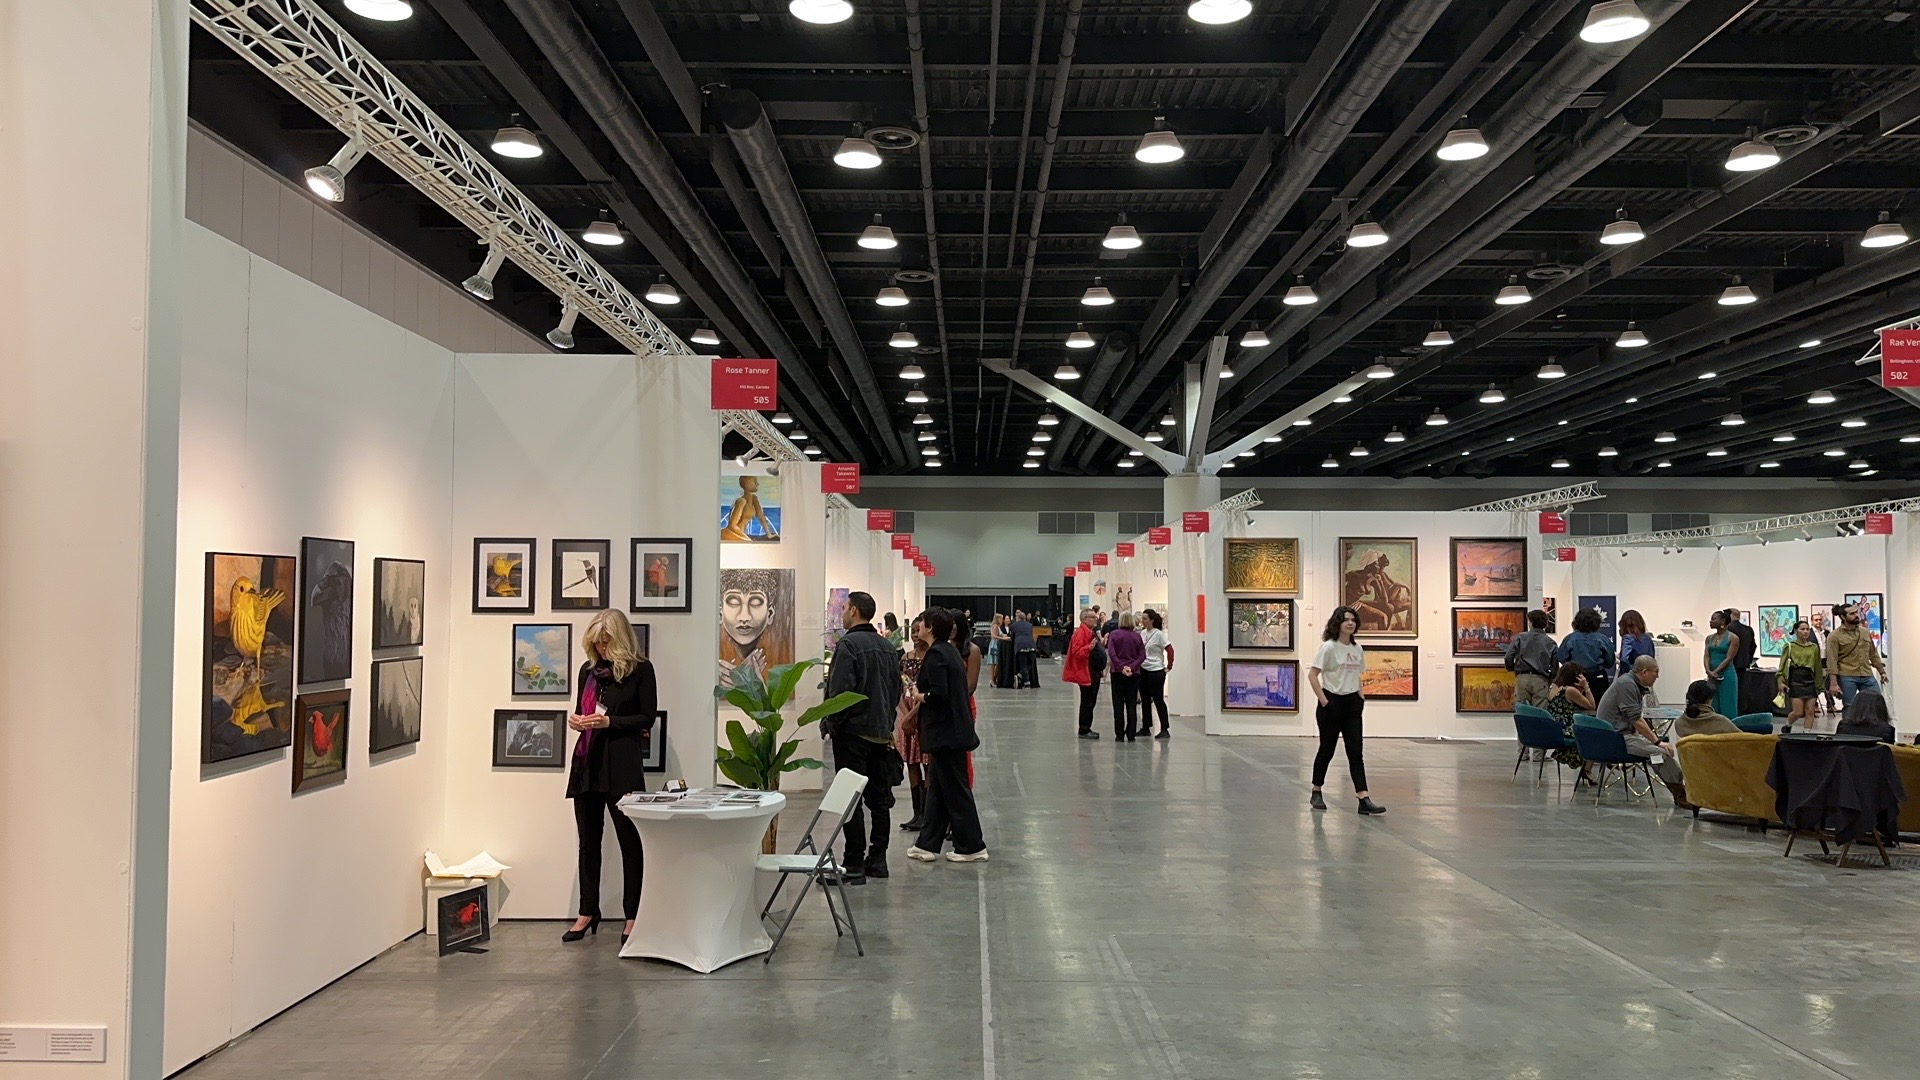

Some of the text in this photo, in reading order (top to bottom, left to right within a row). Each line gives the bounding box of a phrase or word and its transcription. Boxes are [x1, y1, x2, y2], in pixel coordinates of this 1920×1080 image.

[1889, 338, 1905, 347] Rae
[725, 366, 743, 374] Rose
[1890, 371, 1908, 380] 502
[753, 396, 770, 404] 505
[1153, 568, 1169, 578] MA
